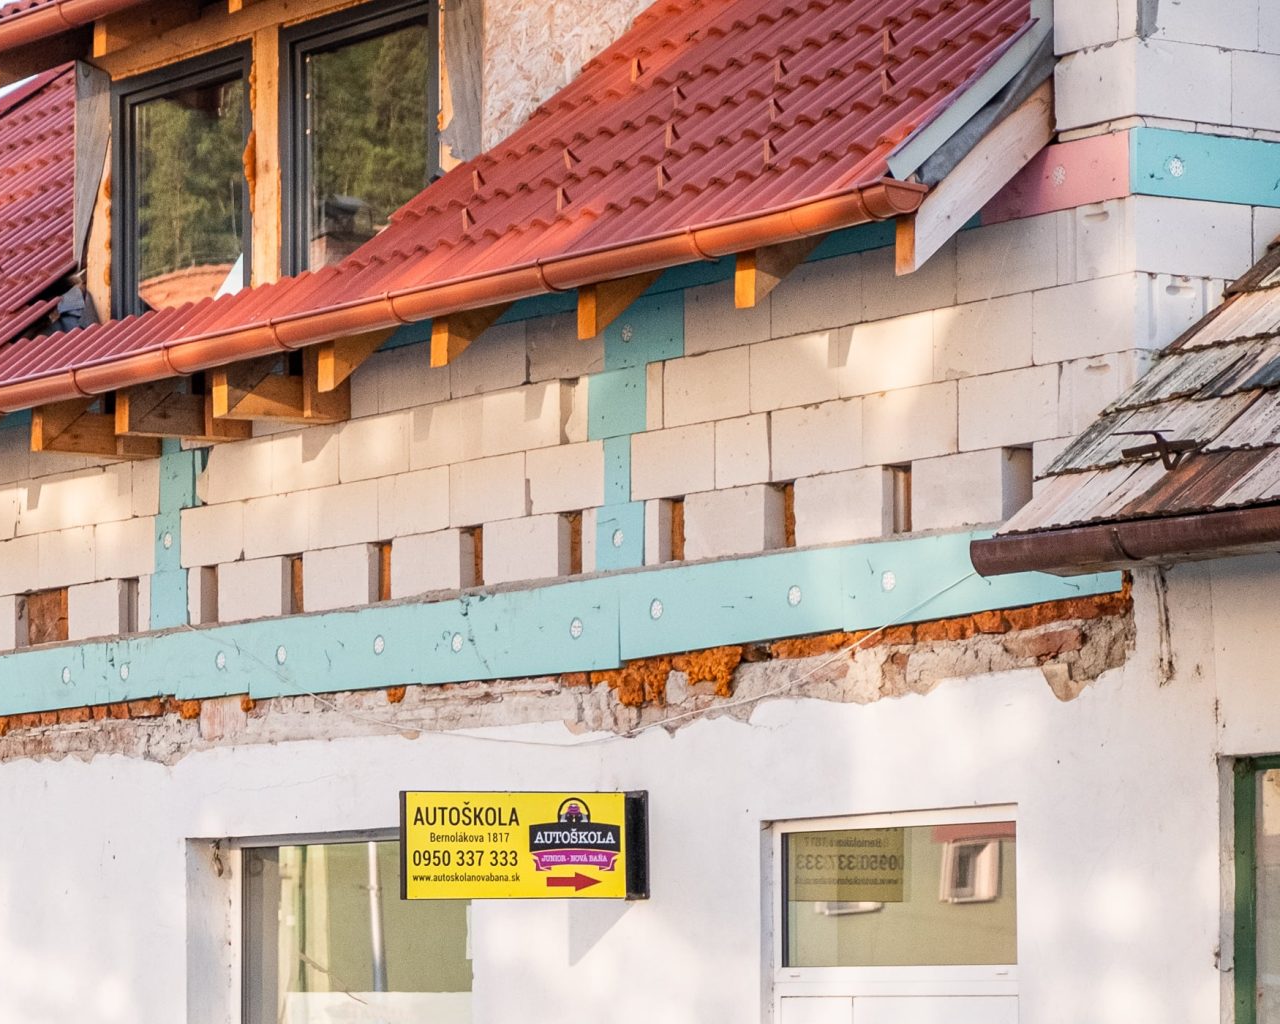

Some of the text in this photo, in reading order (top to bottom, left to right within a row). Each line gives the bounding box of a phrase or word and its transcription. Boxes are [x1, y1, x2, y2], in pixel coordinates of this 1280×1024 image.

[413, 801, 520, 826] AUTOŠKOLA
[429, 832, 510, 843] Bernolákova 1817
[534, 828, 616, 844] AUTOŠKOLA
[412, 850, 518, 867] 0950 337 333
[541, 854, 567, 862] JUNIOR
[570, 853, 588, 862] NOVÁ
[588, 853, 608, 862] BAŇA
[412, 872, 521, 882] www.autoskolanovabana.sk
